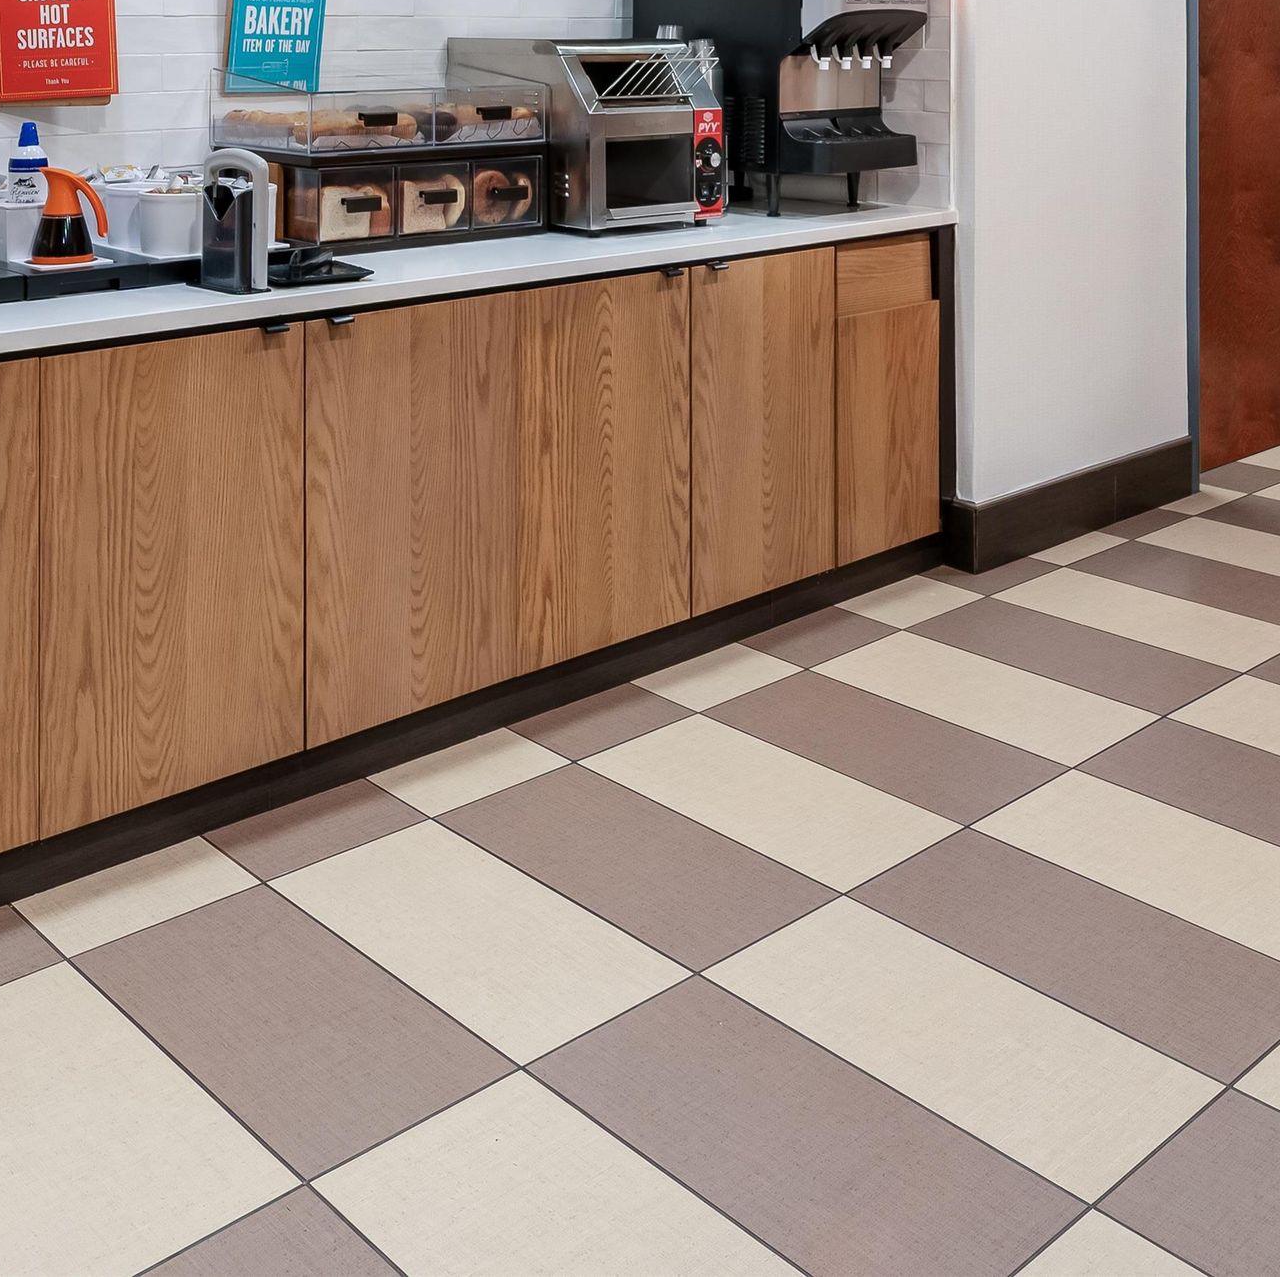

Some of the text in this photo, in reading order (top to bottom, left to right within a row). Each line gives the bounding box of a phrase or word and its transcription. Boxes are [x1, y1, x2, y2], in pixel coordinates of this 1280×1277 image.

[40, 4, 70, 25] HOT
[244, 5, 314, 36] BAKERY
[17, 26, 94, 50] SURFACES
[242, 38, 311, 54] ITEM OF THE DAY
[23, 58, 89, 69] PLEASE BE CAREFUL
